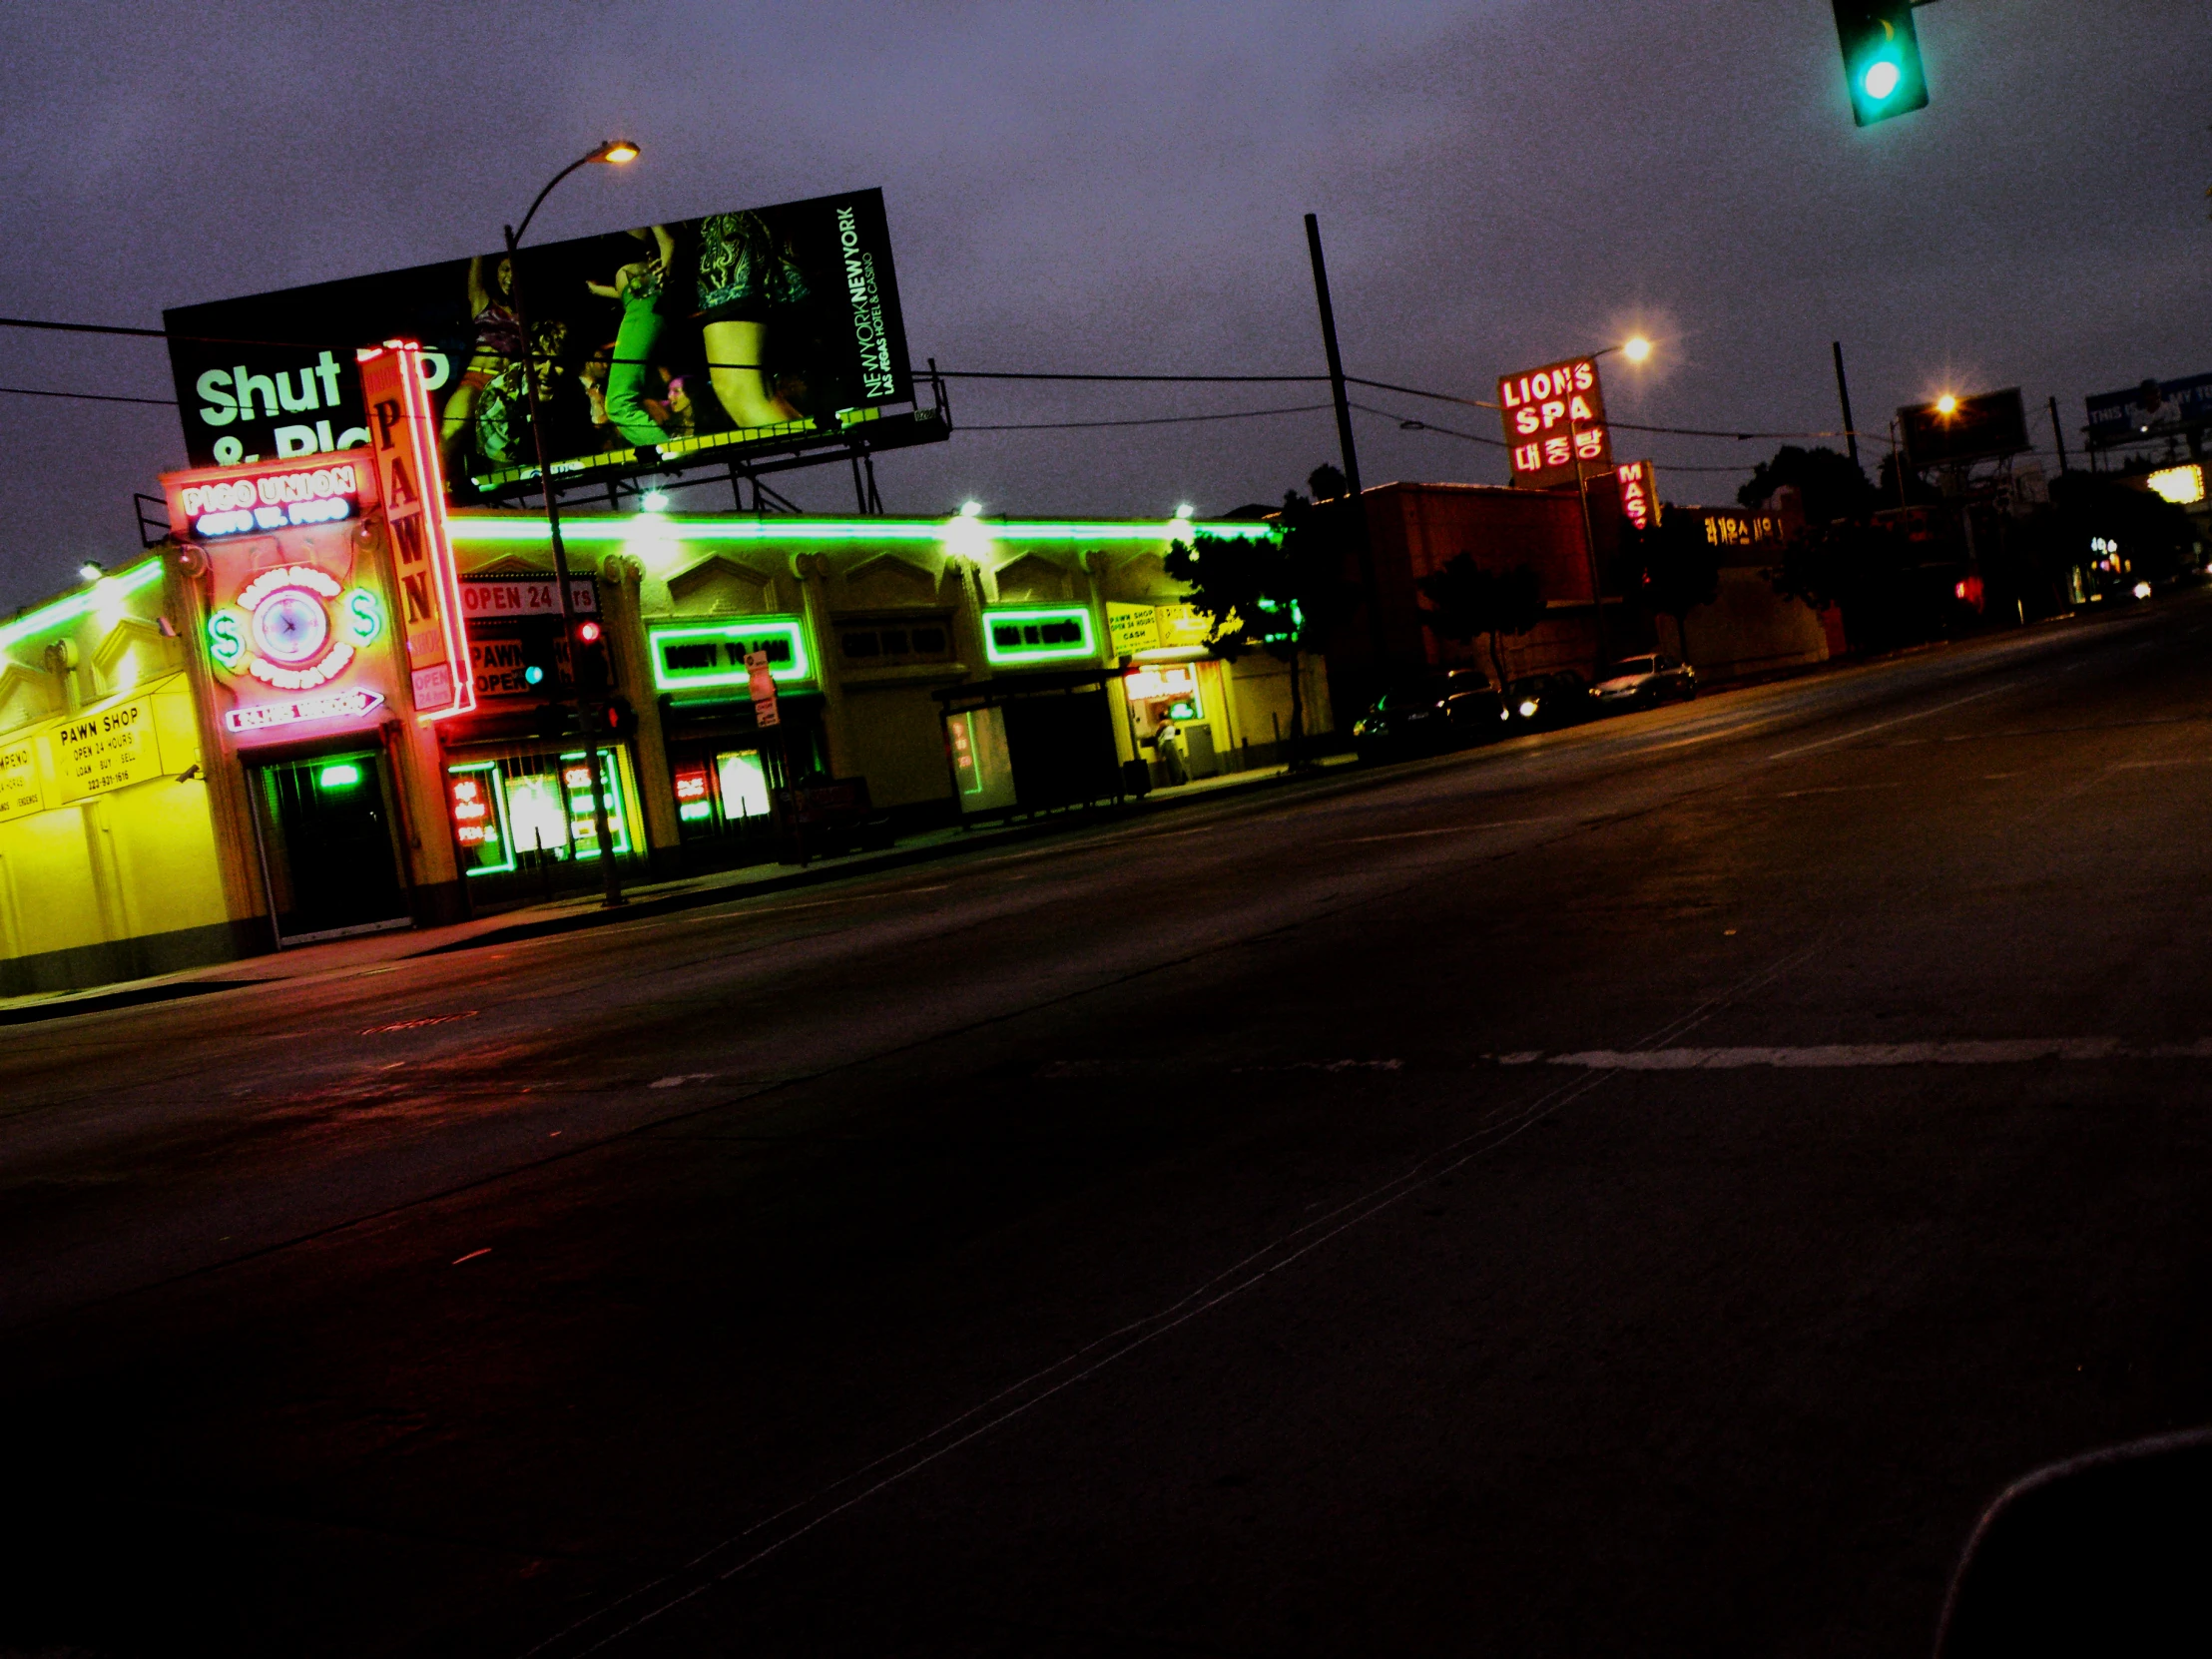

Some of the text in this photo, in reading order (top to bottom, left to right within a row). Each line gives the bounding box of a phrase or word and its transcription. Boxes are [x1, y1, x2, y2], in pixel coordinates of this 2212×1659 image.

[861, 252, 878, 293] CASINO
[870, 303, 885, 336] HOTEL
[876, 337, 891, 371] VEGAS
[197, 350, 341, 426] Shut
[881, 373, 895, 395] LAS
[1503, 361, 1594, 407] LIONS
[1516, 395, 1593, 434] SPA
[1514, 428, 1604, 472] 대중탕
[181, 466, 357, 517] PICO UNION
[373, 398, 431, 625] PAWN
[464, 586, 521, 610] OPEN
[527, 585, 553, 608] 24
[1123, 630, 1146, 641] CASH
[414, 670, 447, 691] OPEN
[60, 707, 139, 747] PAWN SHOP
[73, 732, 133, 762] OPEN 24 HOURS
[76, 765, 92, 778] LOAN
[100, 759, 112, 771] BUY
[88, 770, 130, 792] 323-931-1616
